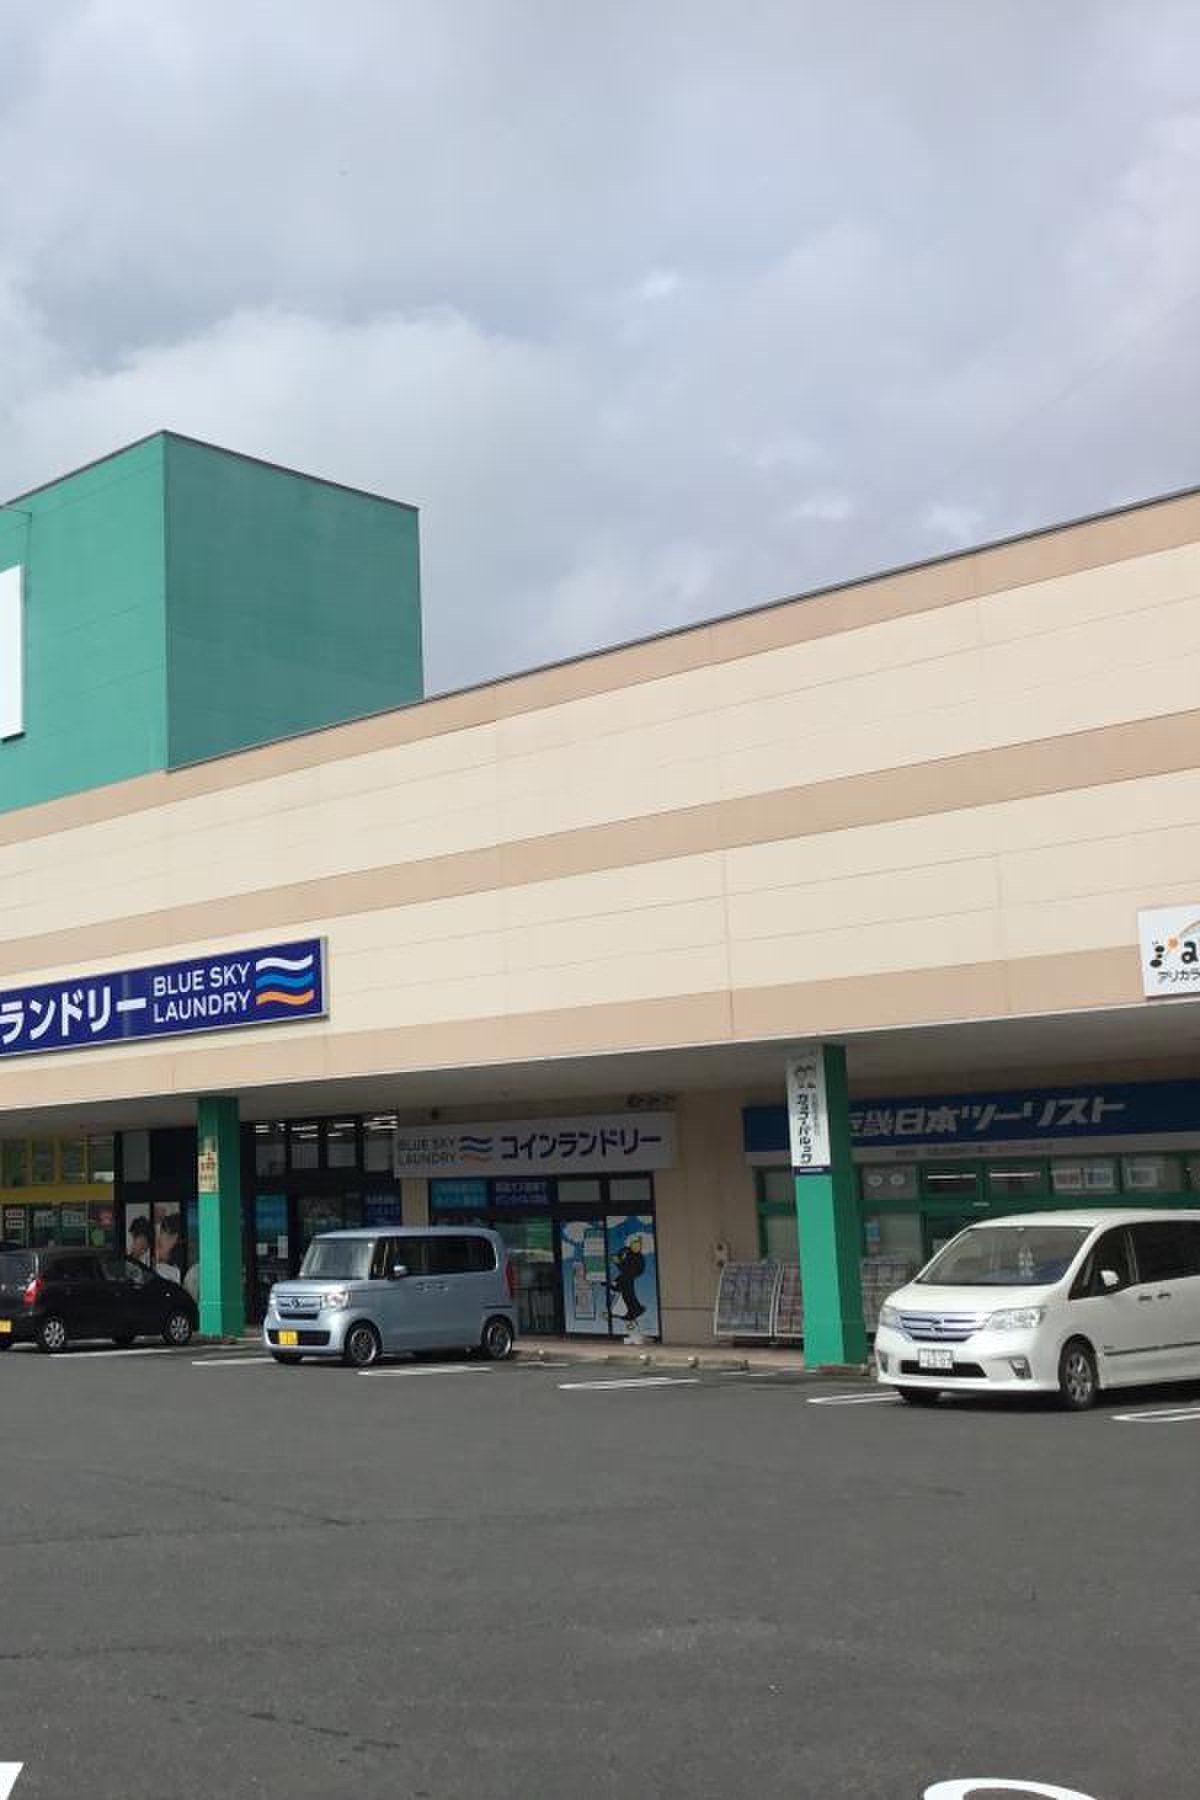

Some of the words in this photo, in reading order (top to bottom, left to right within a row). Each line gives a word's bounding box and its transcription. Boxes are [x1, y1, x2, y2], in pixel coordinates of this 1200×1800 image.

[153, 968, 205, 998] BLUE
[209, 961, 251, 989] SKY
[153, 989, 252, 1024] LAUNDRY
[399, 1137, 432, 1152] BLUE
[434, 1136, 456, 1150] SKY
[399, 1151, 456, 1167] LAUNDRY
[500, 1127, 663, 1161] コインランドリー
